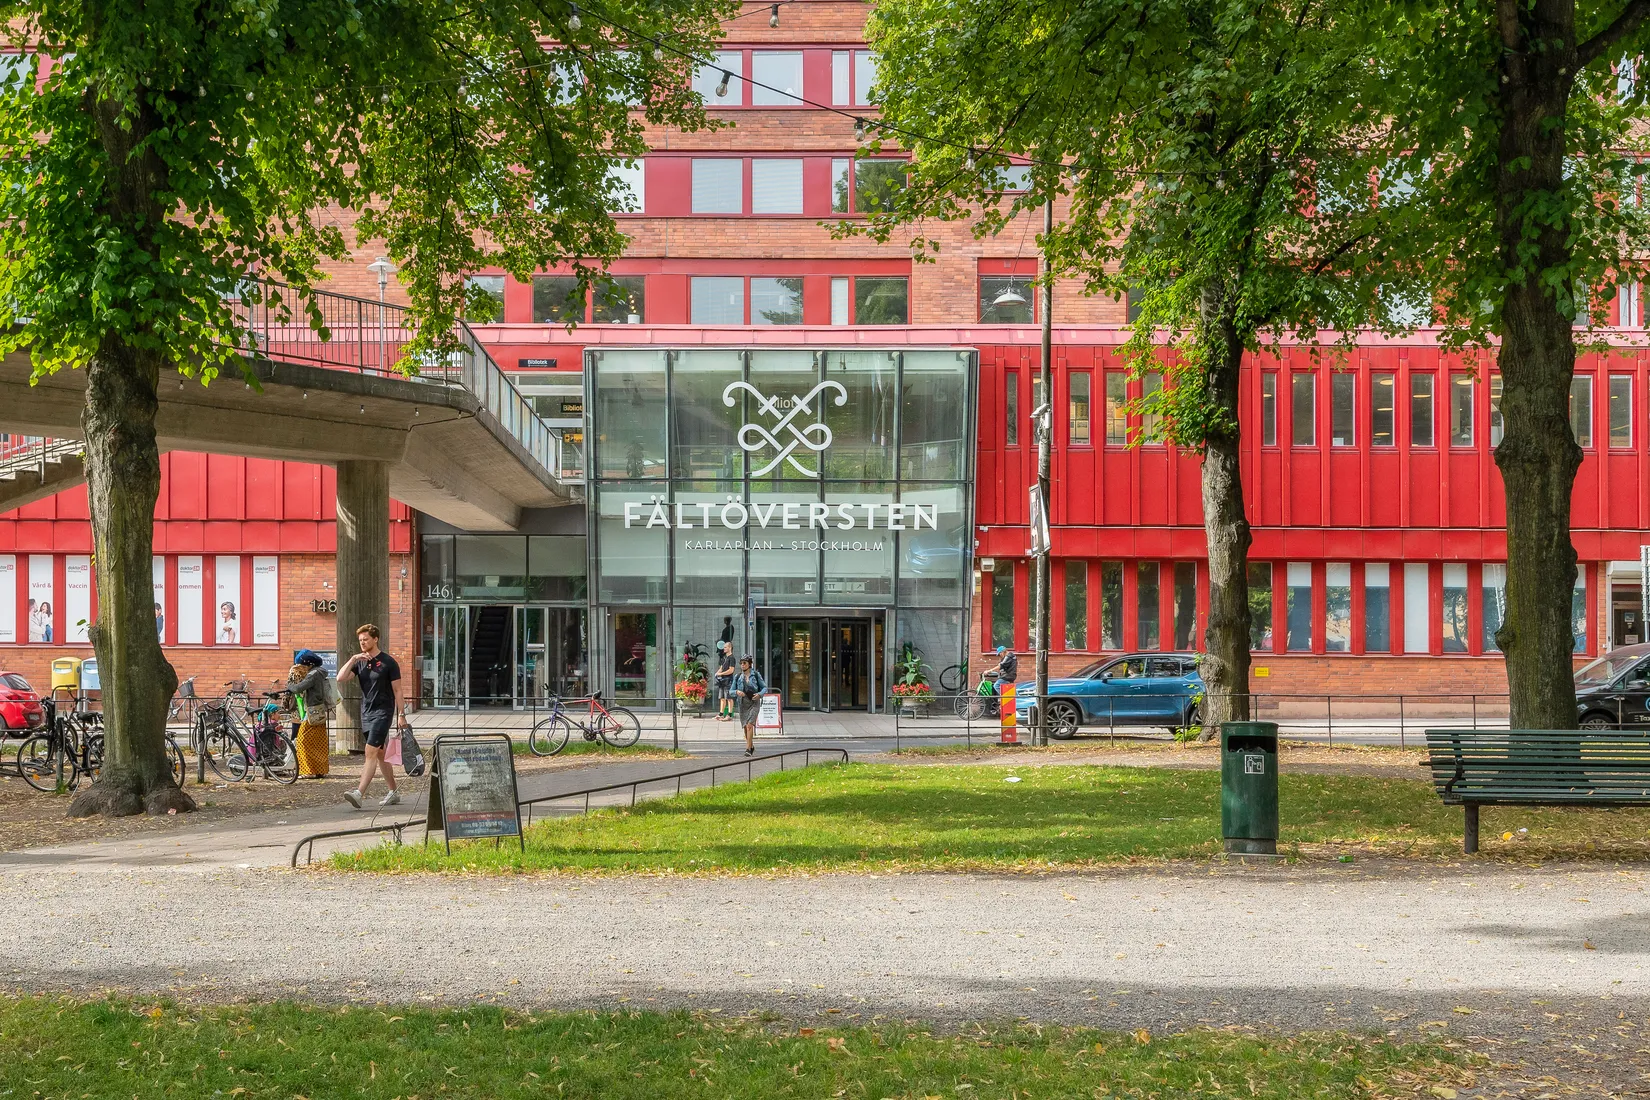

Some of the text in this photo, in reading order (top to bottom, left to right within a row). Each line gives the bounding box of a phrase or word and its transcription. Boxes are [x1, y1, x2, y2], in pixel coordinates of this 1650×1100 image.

[624, 495, 938, 531] FÄLTÖVERSTEN
[685, 540, 884, 552] KARLAPLAN STOCKHOLM
[427, 584, 450, 598] 146
[310, 599, 337, 613] 146
